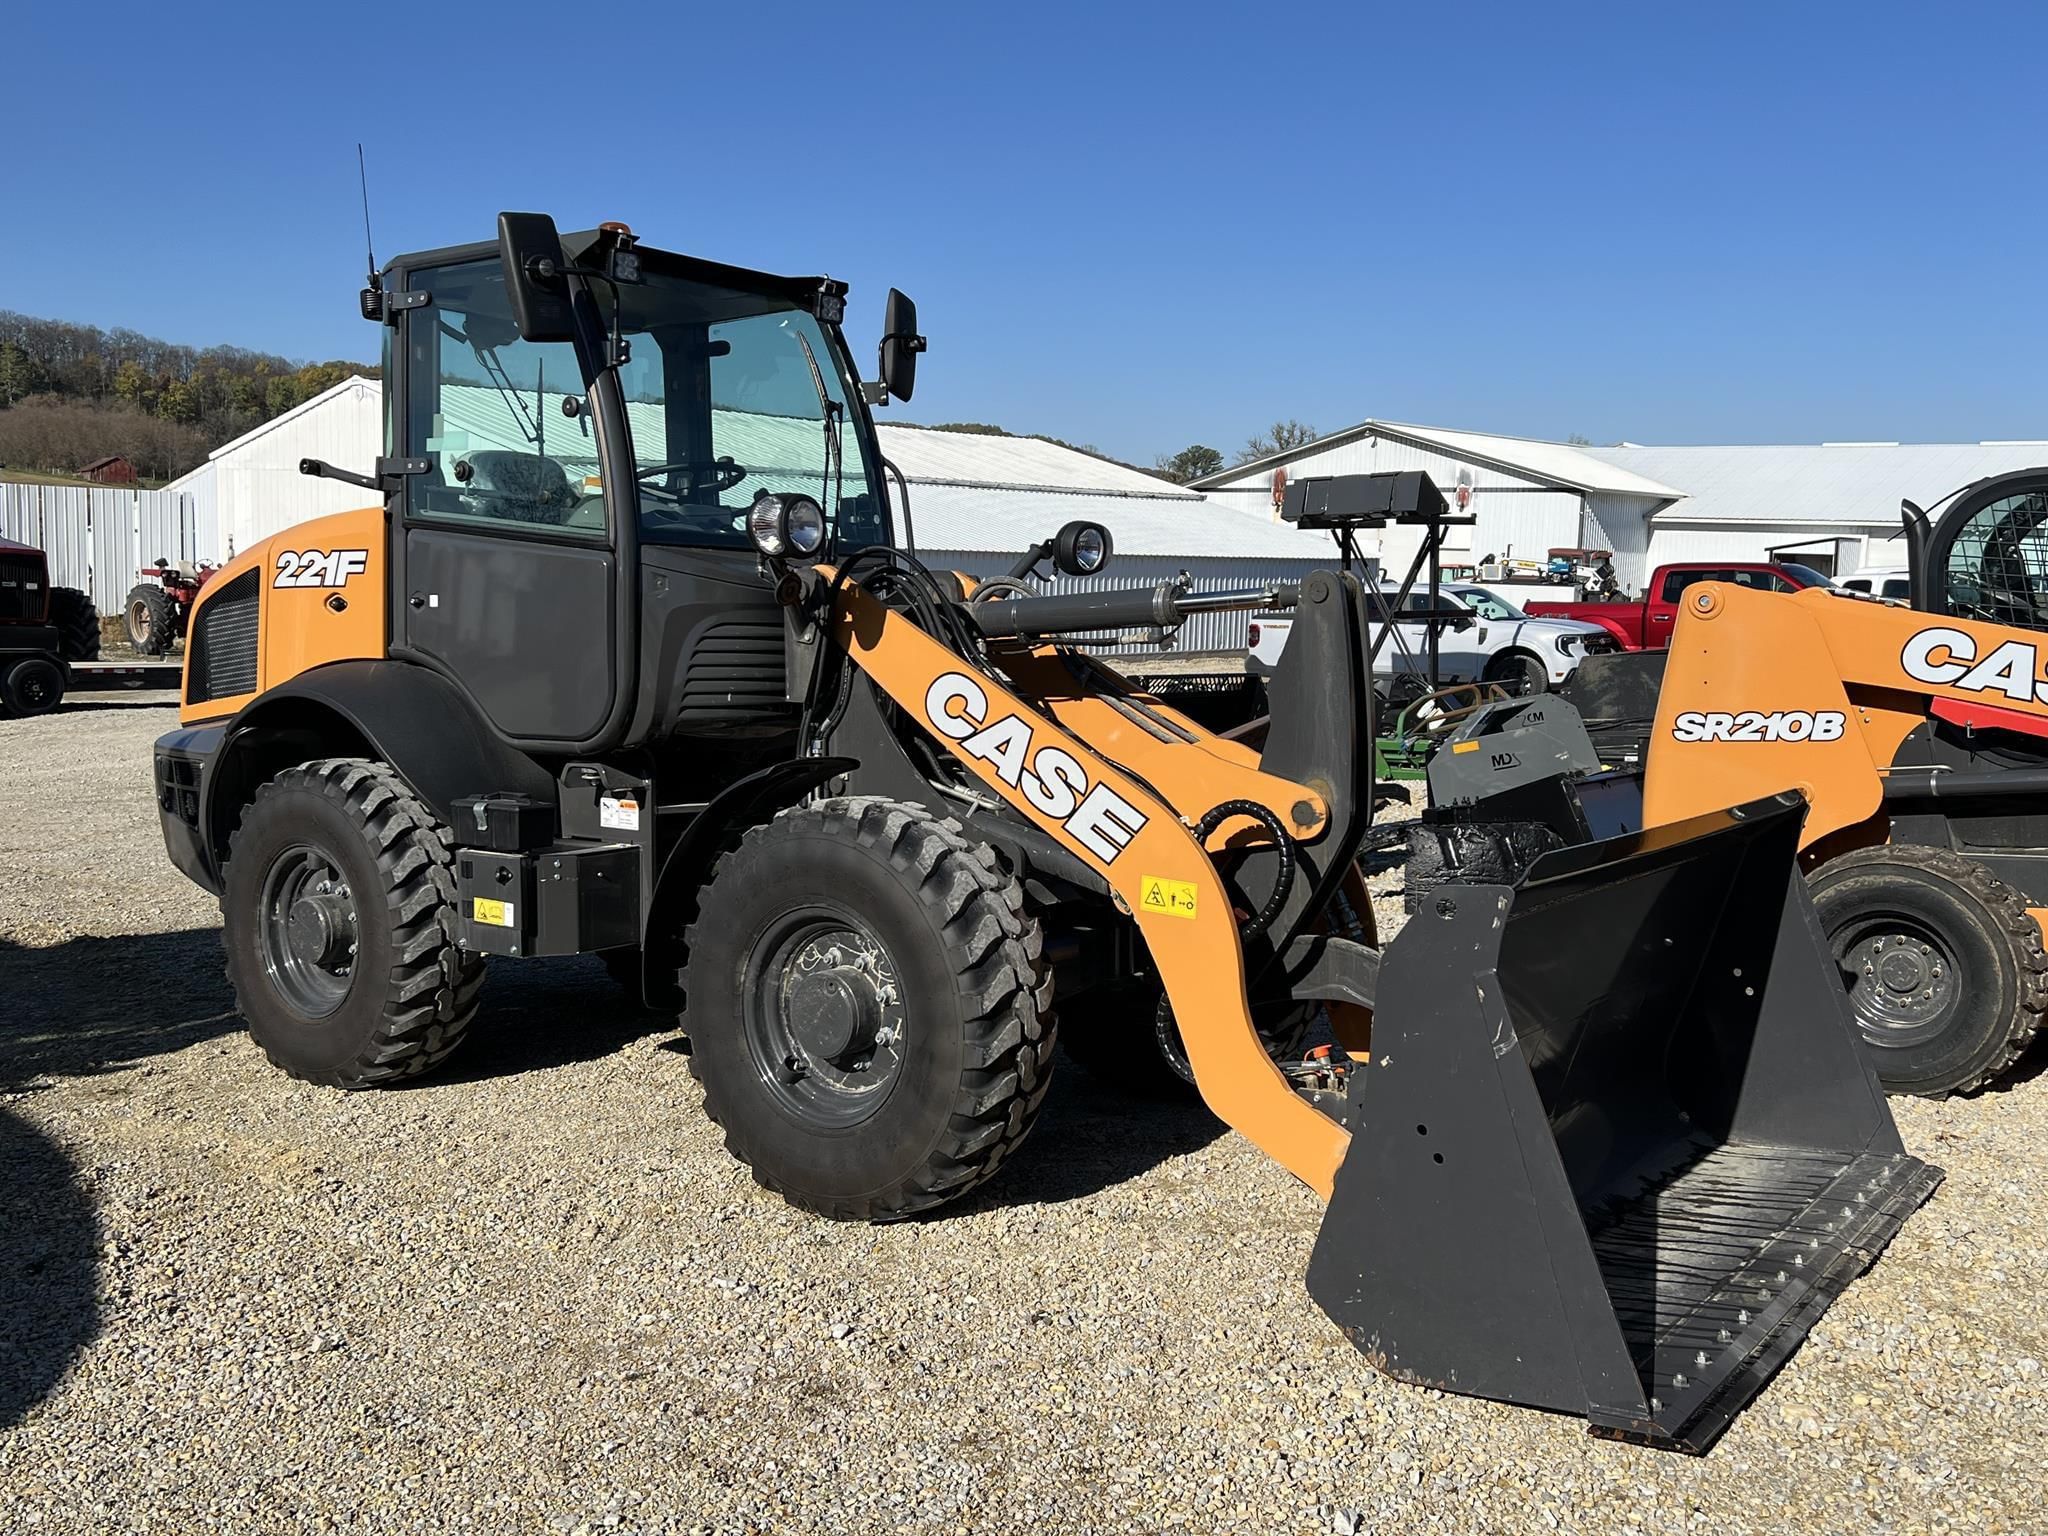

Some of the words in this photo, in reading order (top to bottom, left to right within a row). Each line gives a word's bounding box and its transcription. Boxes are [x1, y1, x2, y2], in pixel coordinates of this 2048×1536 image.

[273, 549, 369, 589] 221F
[1900, 627, 2048, 705] CA
[1672, 710, 1846, 743] SR210B
[925, 671, 1150, 866] CASE
